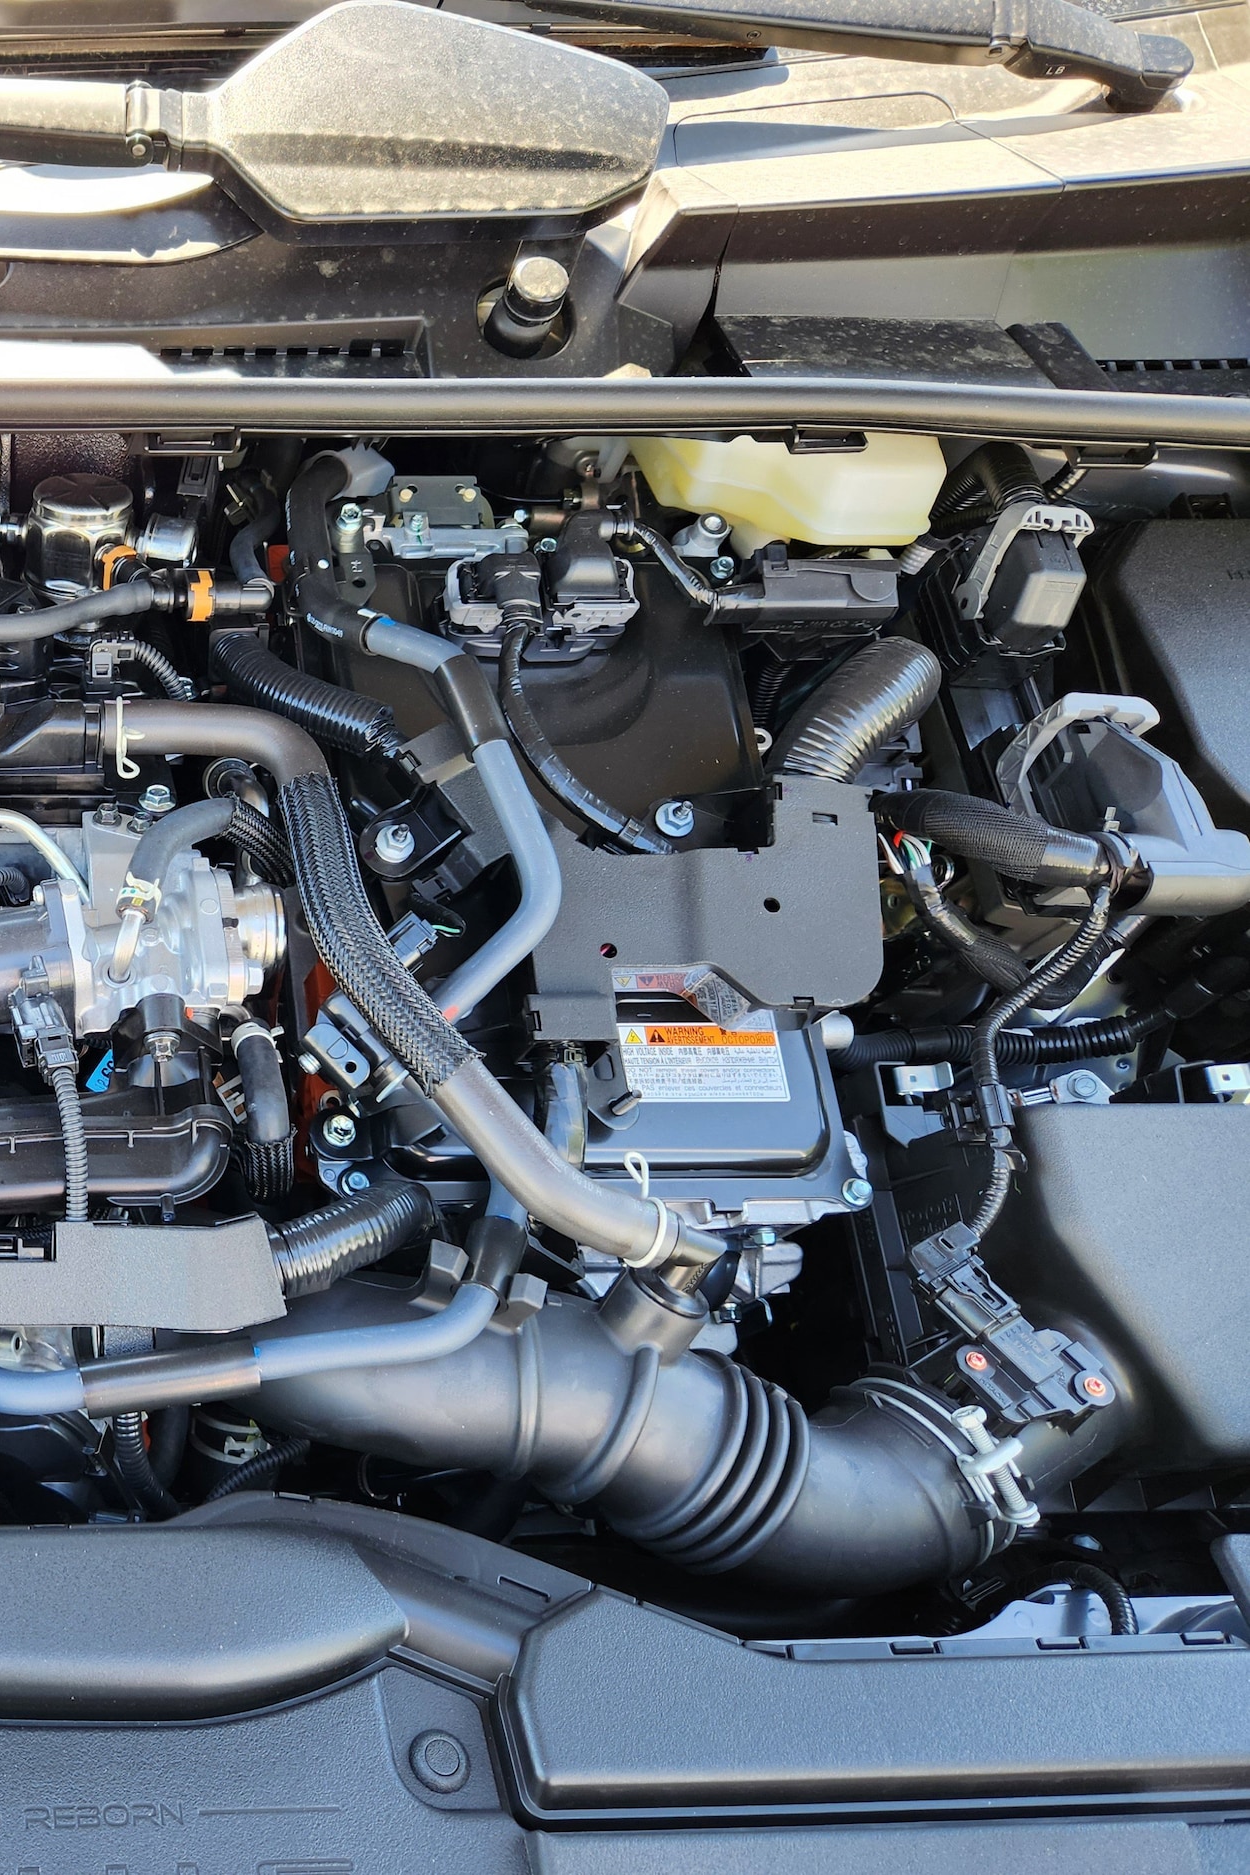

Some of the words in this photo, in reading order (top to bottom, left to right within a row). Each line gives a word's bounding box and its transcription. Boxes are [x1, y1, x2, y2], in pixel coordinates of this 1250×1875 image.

[666, 1028, 704, 1036] WARNING
[667, 1036, 715, 1044] AVERTISSEMENT
[980, 1378, 1007, 1405] HITACHI
[21, 1802, 184, 1832] REBORN
